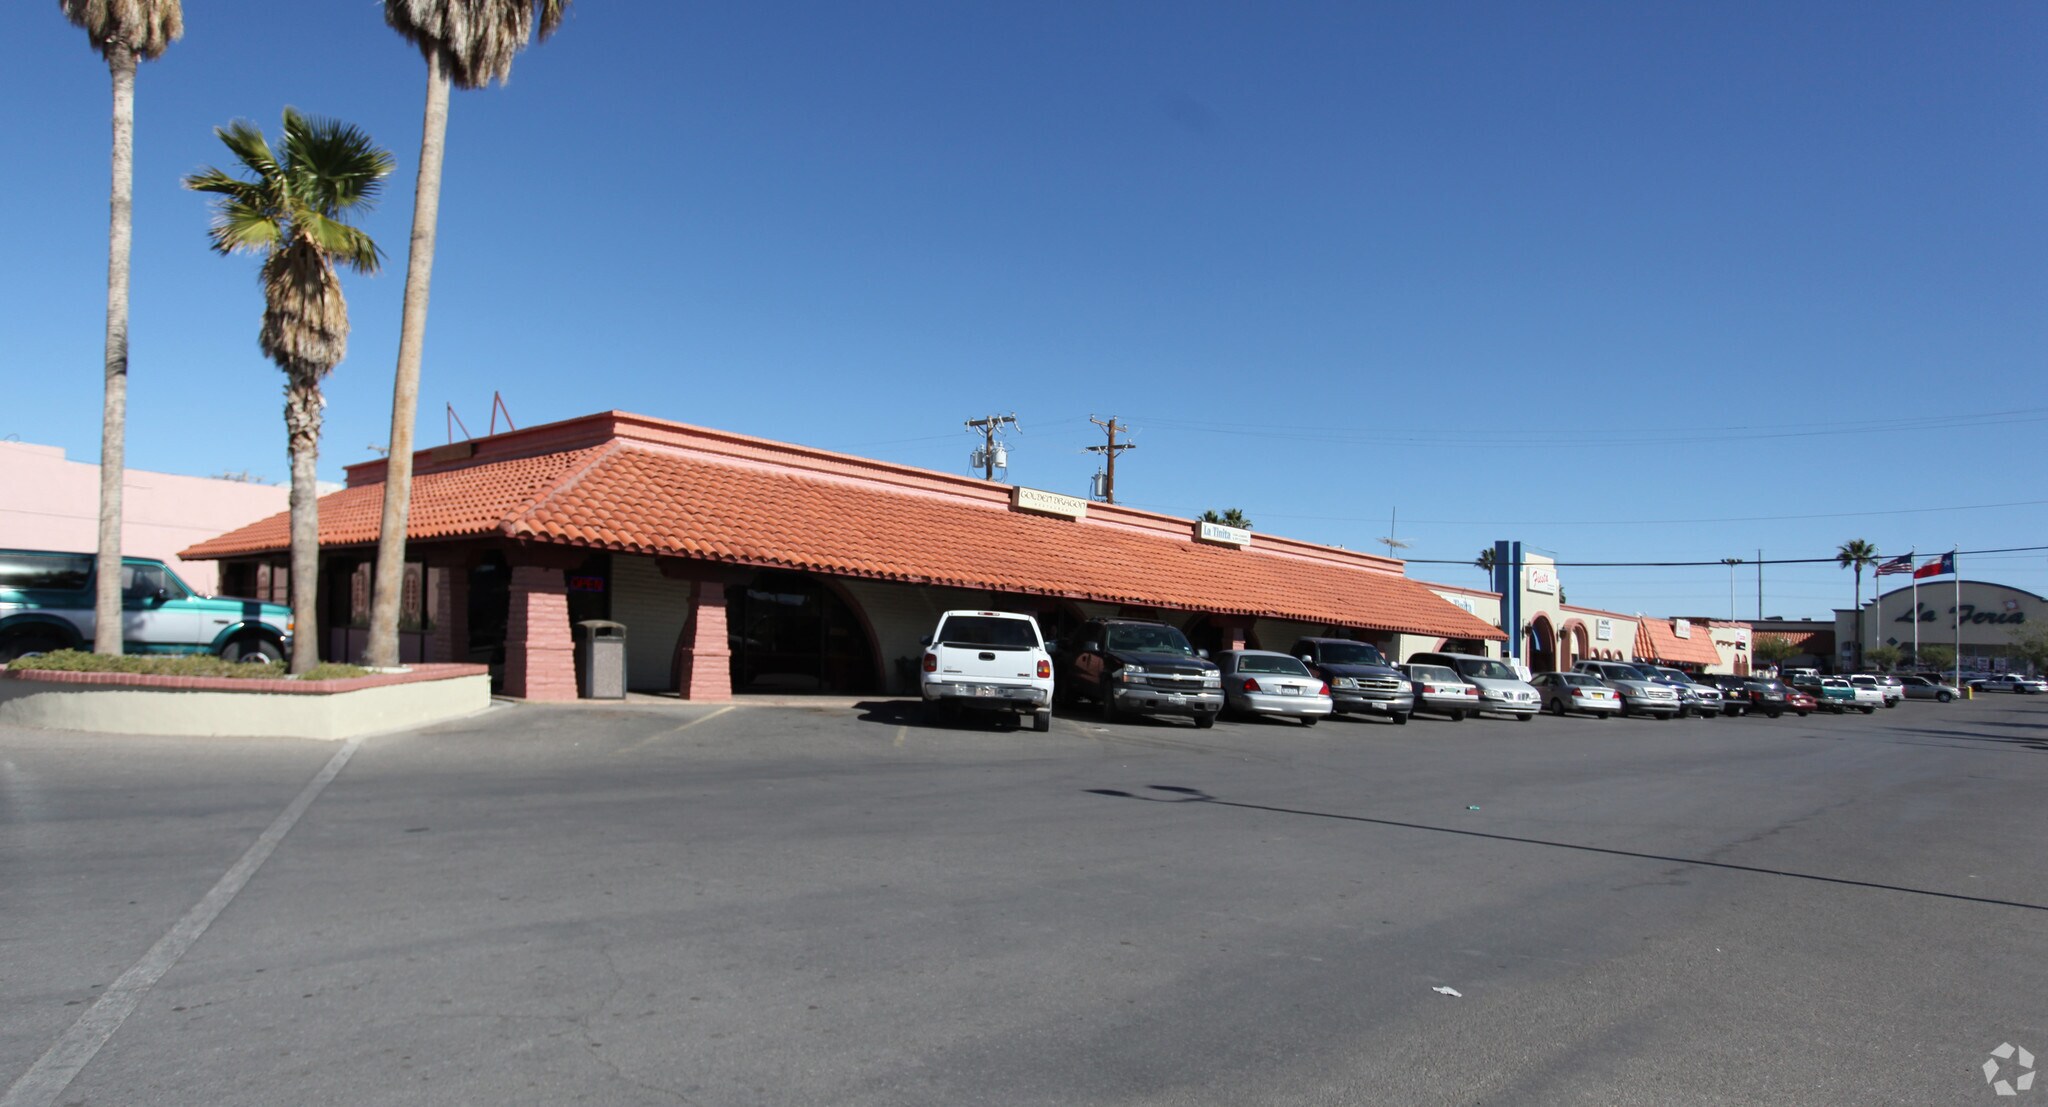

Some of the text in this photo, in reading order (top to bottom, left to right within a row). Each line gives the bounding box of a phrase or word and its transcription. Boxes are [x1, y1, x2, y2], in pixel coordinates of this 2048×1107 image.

[1020, 490, 1086, 509] GOLDEN DRAGON
[1895, 602, 1937, 623] La
